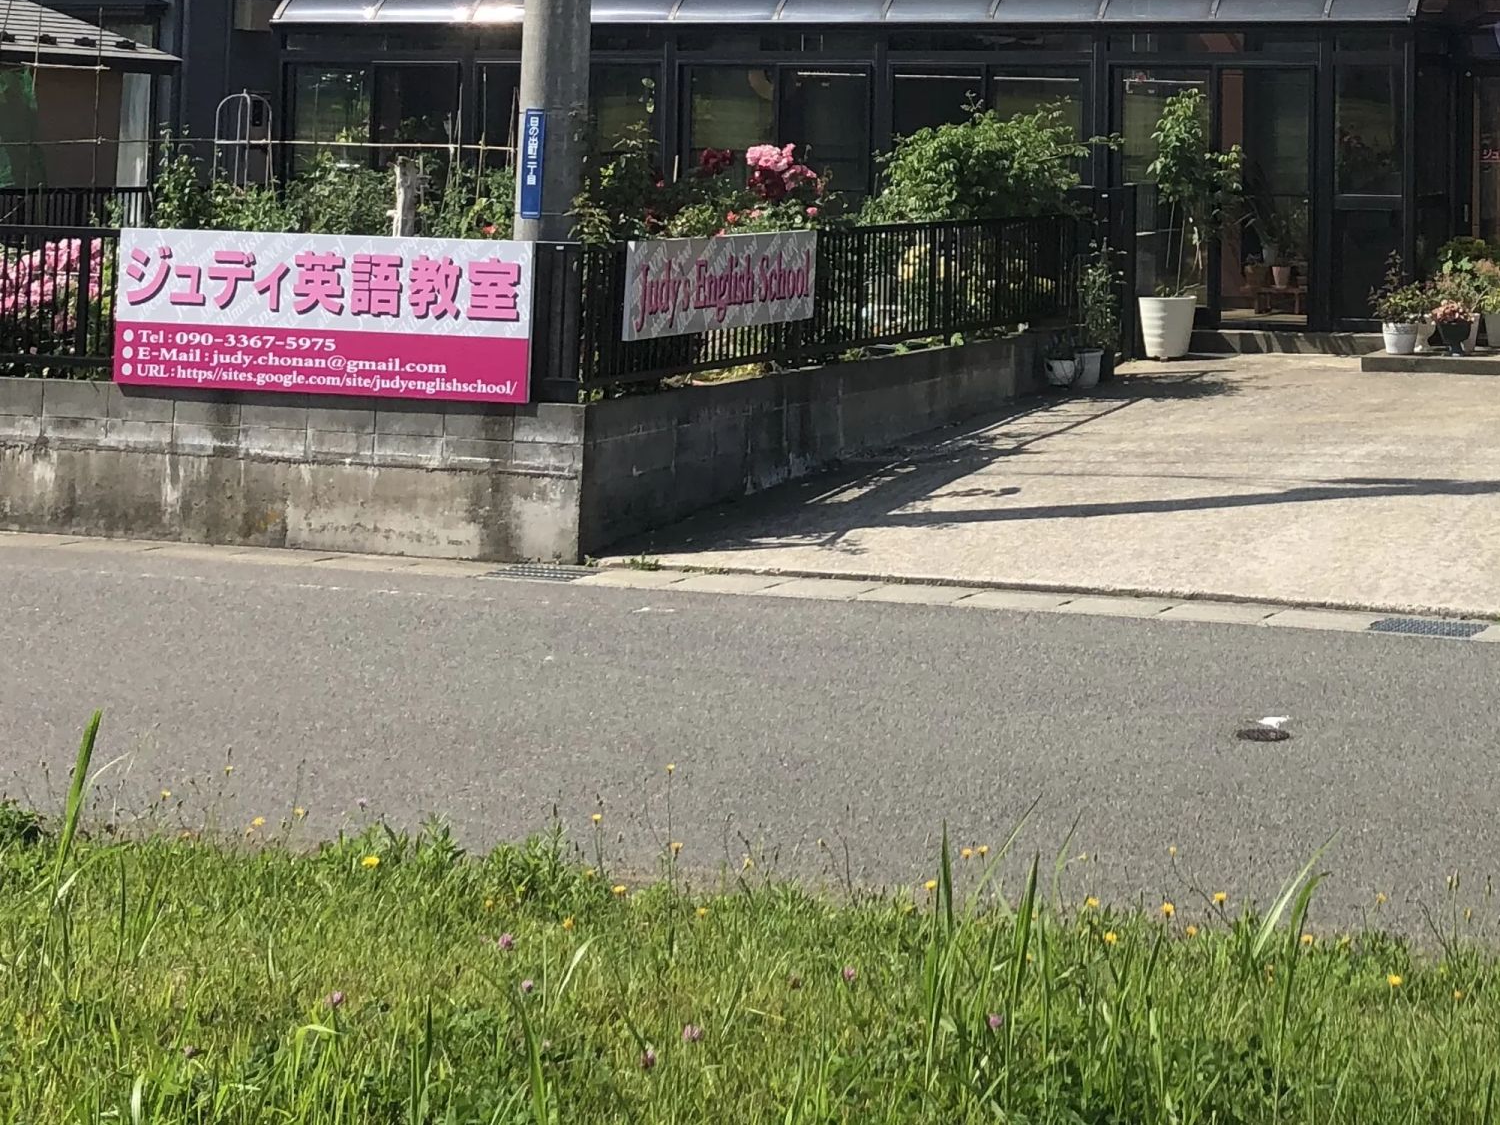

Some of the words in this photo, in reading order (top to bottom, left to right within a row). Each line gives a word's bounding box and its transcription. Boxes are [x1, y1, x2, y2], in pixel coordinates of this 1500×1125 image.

[126, 246, 521, 322] ジュディ英語教室
[634, 258, 690, 333] Judy's
[693, 253, 755, 323] English
[758, 248, 811, 303] School
